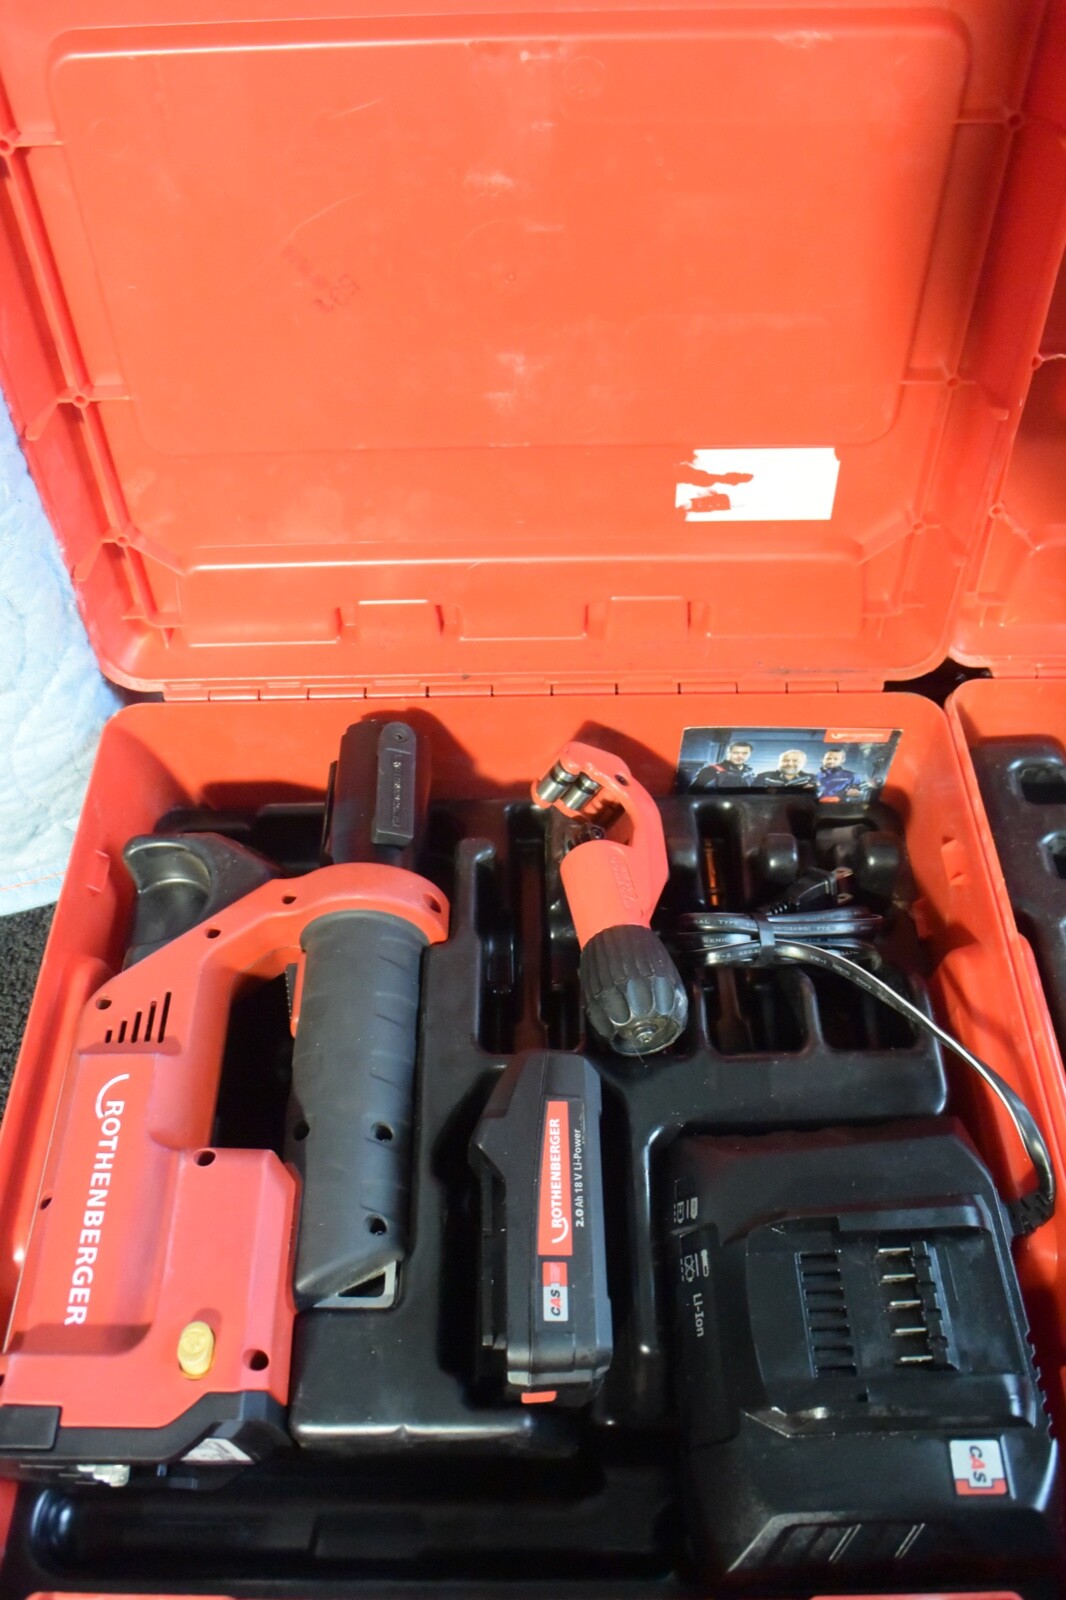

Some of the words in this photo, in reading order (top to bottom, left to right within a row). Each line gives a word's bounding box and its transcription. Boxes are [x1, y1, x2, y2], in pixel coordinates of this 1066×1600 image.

[573, 1128, 583, 1171] Li-Power
[549, 1118, 563, 1229] ROTHENBERGER
[574, 1173, 583, 1182] V
[574, 1181, 584, 1193] 18
[64, 1100, 125, 1326] ROTHENBERGER
[574, 1195, 584, 1208] Ah
[575, 1210, 585, 1228] 2.0
[550, 1288, 562, 1317] CAS
[969, 1445, 987, 1483] CAS
